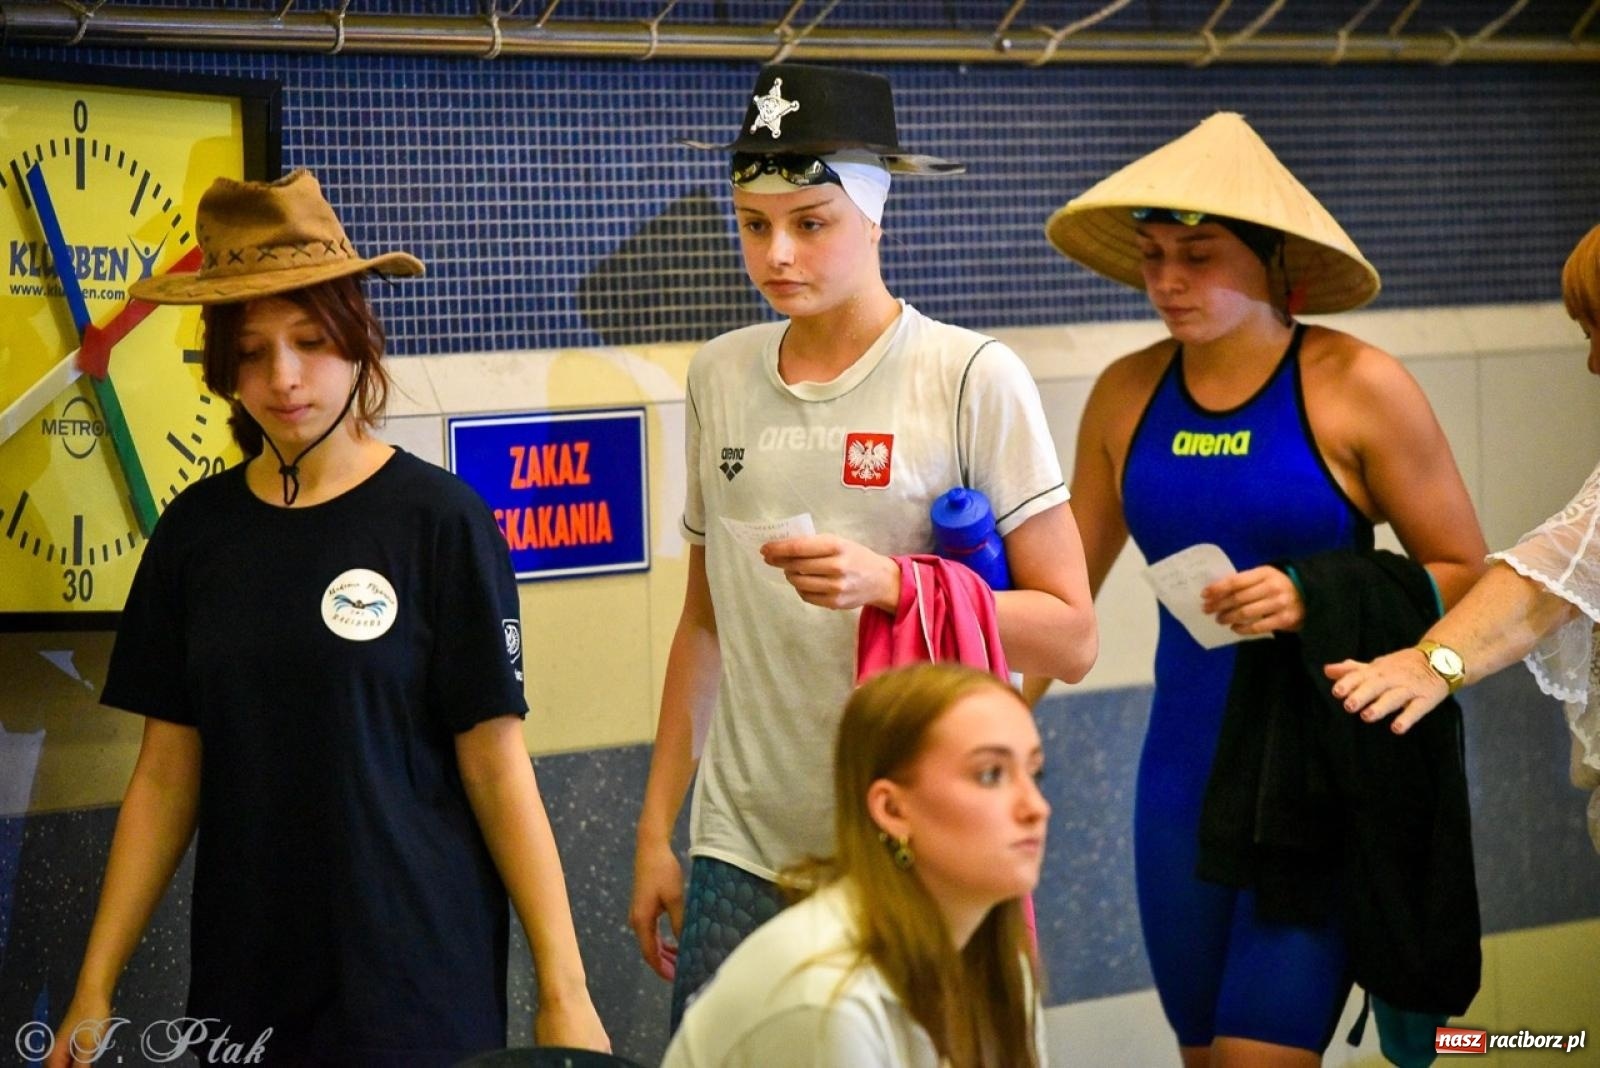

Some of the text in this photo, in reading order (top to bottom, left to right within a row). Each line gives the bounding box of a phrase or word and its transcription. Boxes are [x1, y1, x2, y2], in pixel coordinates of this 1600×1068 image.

[74, 100, 88, 133] 0
[10, 284, 126, 300] www.kluen.com
[42, 418, 109, 437] METRO
[758, 426, 847, 451] arena
[1172, 430, 1250, 456] arena
[509, 442, 591, 489] ZAKAZ
[62, 569, 94, 602] 30
